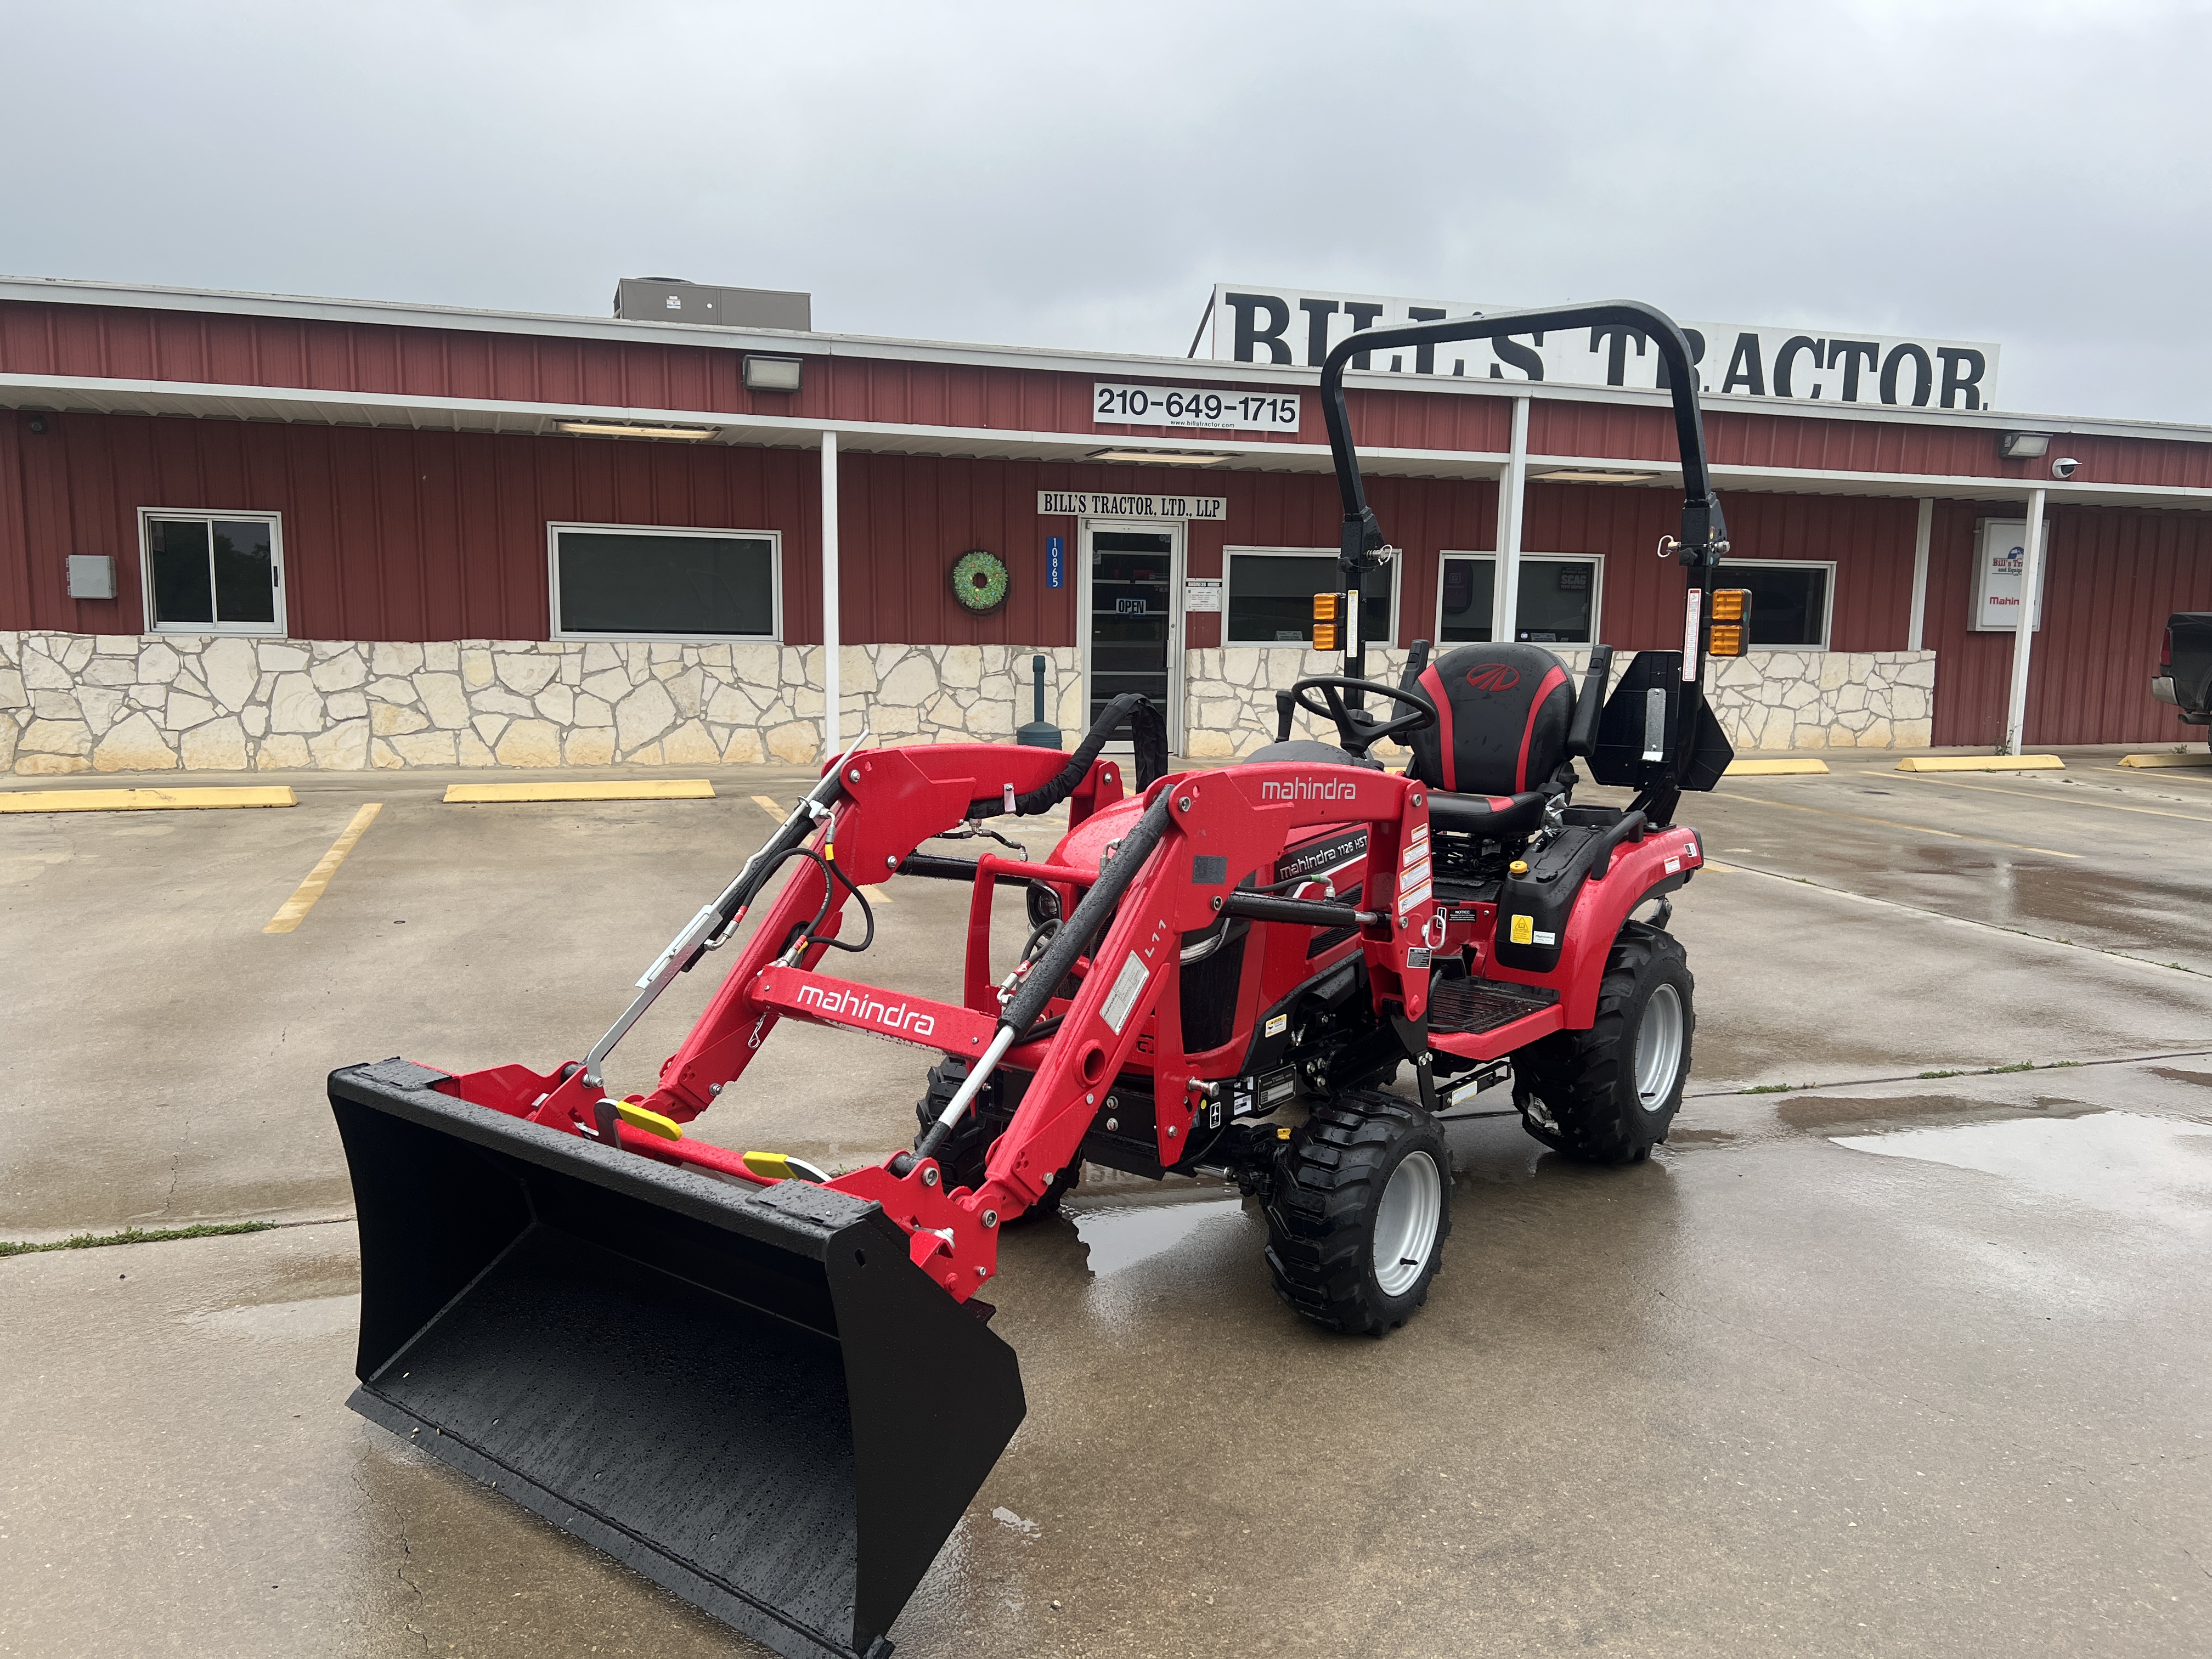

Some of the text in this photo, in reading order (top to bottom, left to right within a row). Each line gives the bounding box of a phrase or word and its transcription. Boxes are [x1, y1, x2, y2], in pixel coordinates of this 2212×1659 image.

[1225, 292, 1544, 382] BILLS
[1098, 387, 1296, 424] 210-649-1715
[1170, 420, 1235, 428] www.billstractor.com
[1044, 493, 1221, 518] BILL'S TRACTOR, LTD., LLP
[1993, 558, 2012, 567] Bill's
[1561, 574, 1587, 585] SCAG
[1118, 600, 1144, 613] OPEN
[1262, 776, 1356, 799] mahindra
[1279, 835, 1368, 880] mahindra 1126 HST
[797, 985, 935, 1036] mahindra
